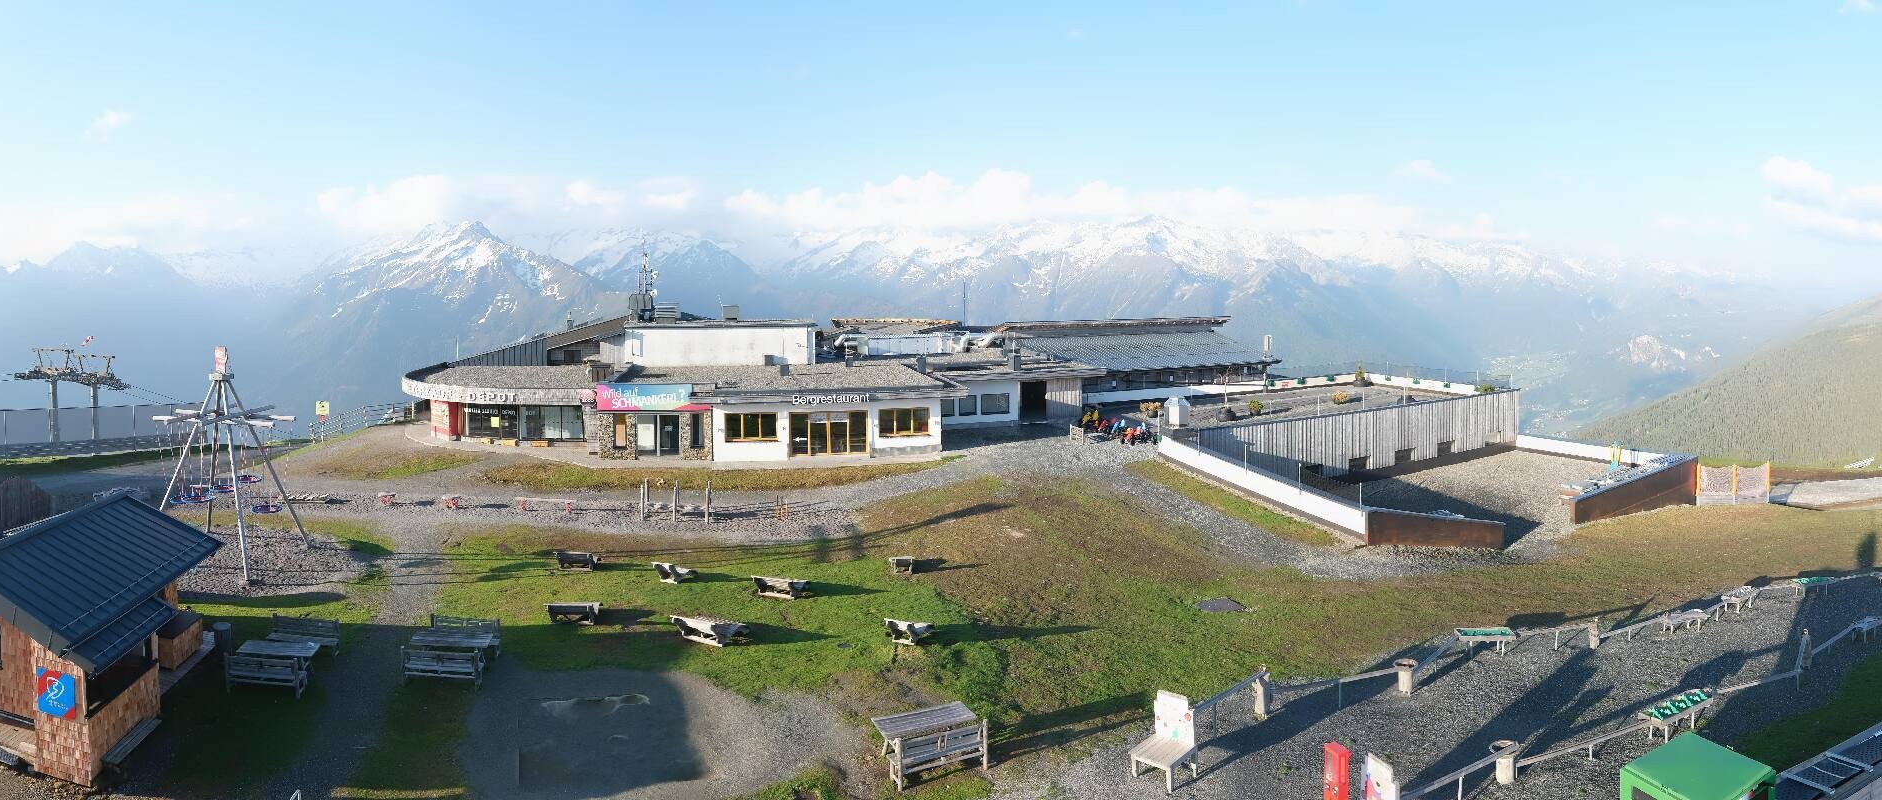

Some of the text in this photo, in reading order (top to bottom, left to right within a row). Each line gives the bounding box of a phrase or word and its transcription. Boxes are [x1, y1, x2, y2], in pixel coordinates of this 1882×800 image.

[468, 392, 518, 402] DEPOT
[602, 388, 622, 400] Wild
[623, 387, 639, 397] auf
[612, 389, 686, 409] SCHMANKERL?
[792, 392, 870, 406] Bergrestaurant
